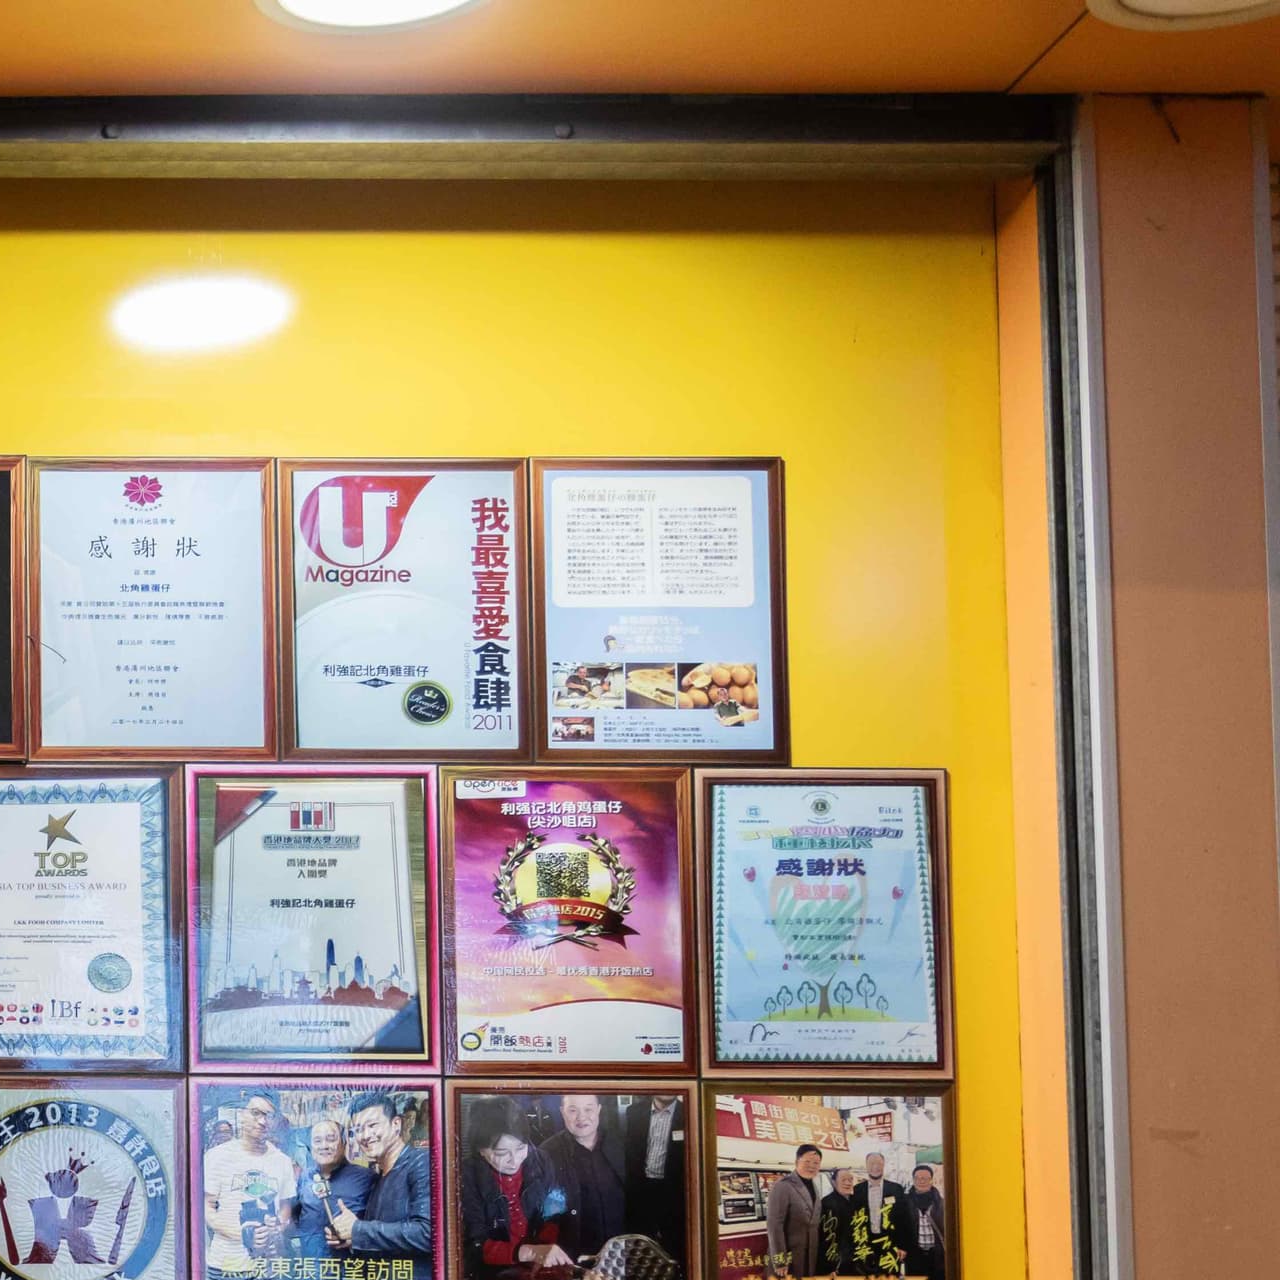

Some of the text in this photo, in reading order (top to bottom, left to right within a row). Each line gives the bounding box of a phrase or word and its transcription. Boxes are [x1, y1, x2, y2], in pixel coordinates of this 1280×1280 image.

[88, 535, 201, 559] 感謝狀
[304, 565, 412, 587] Magazine
[471, 497, 512, 713] 我最喜愛食肆
[322, 664, 429, 678] 利強記北角雞蛋仔
[472, 714, 513, 731] 2011
[500, 800, 622, 815] 利强记北角鸡蛋仔
[527, 815, 597, 828] (尖沙咀店)
[34, 851, 88, 869] TOP
[775, 857, 867, 877] 感謝狀
[35, 869, 88, 877] AWARDS
[16, 882, 35, 890] TOP
[25, 1103, 100, 1128] 2013
